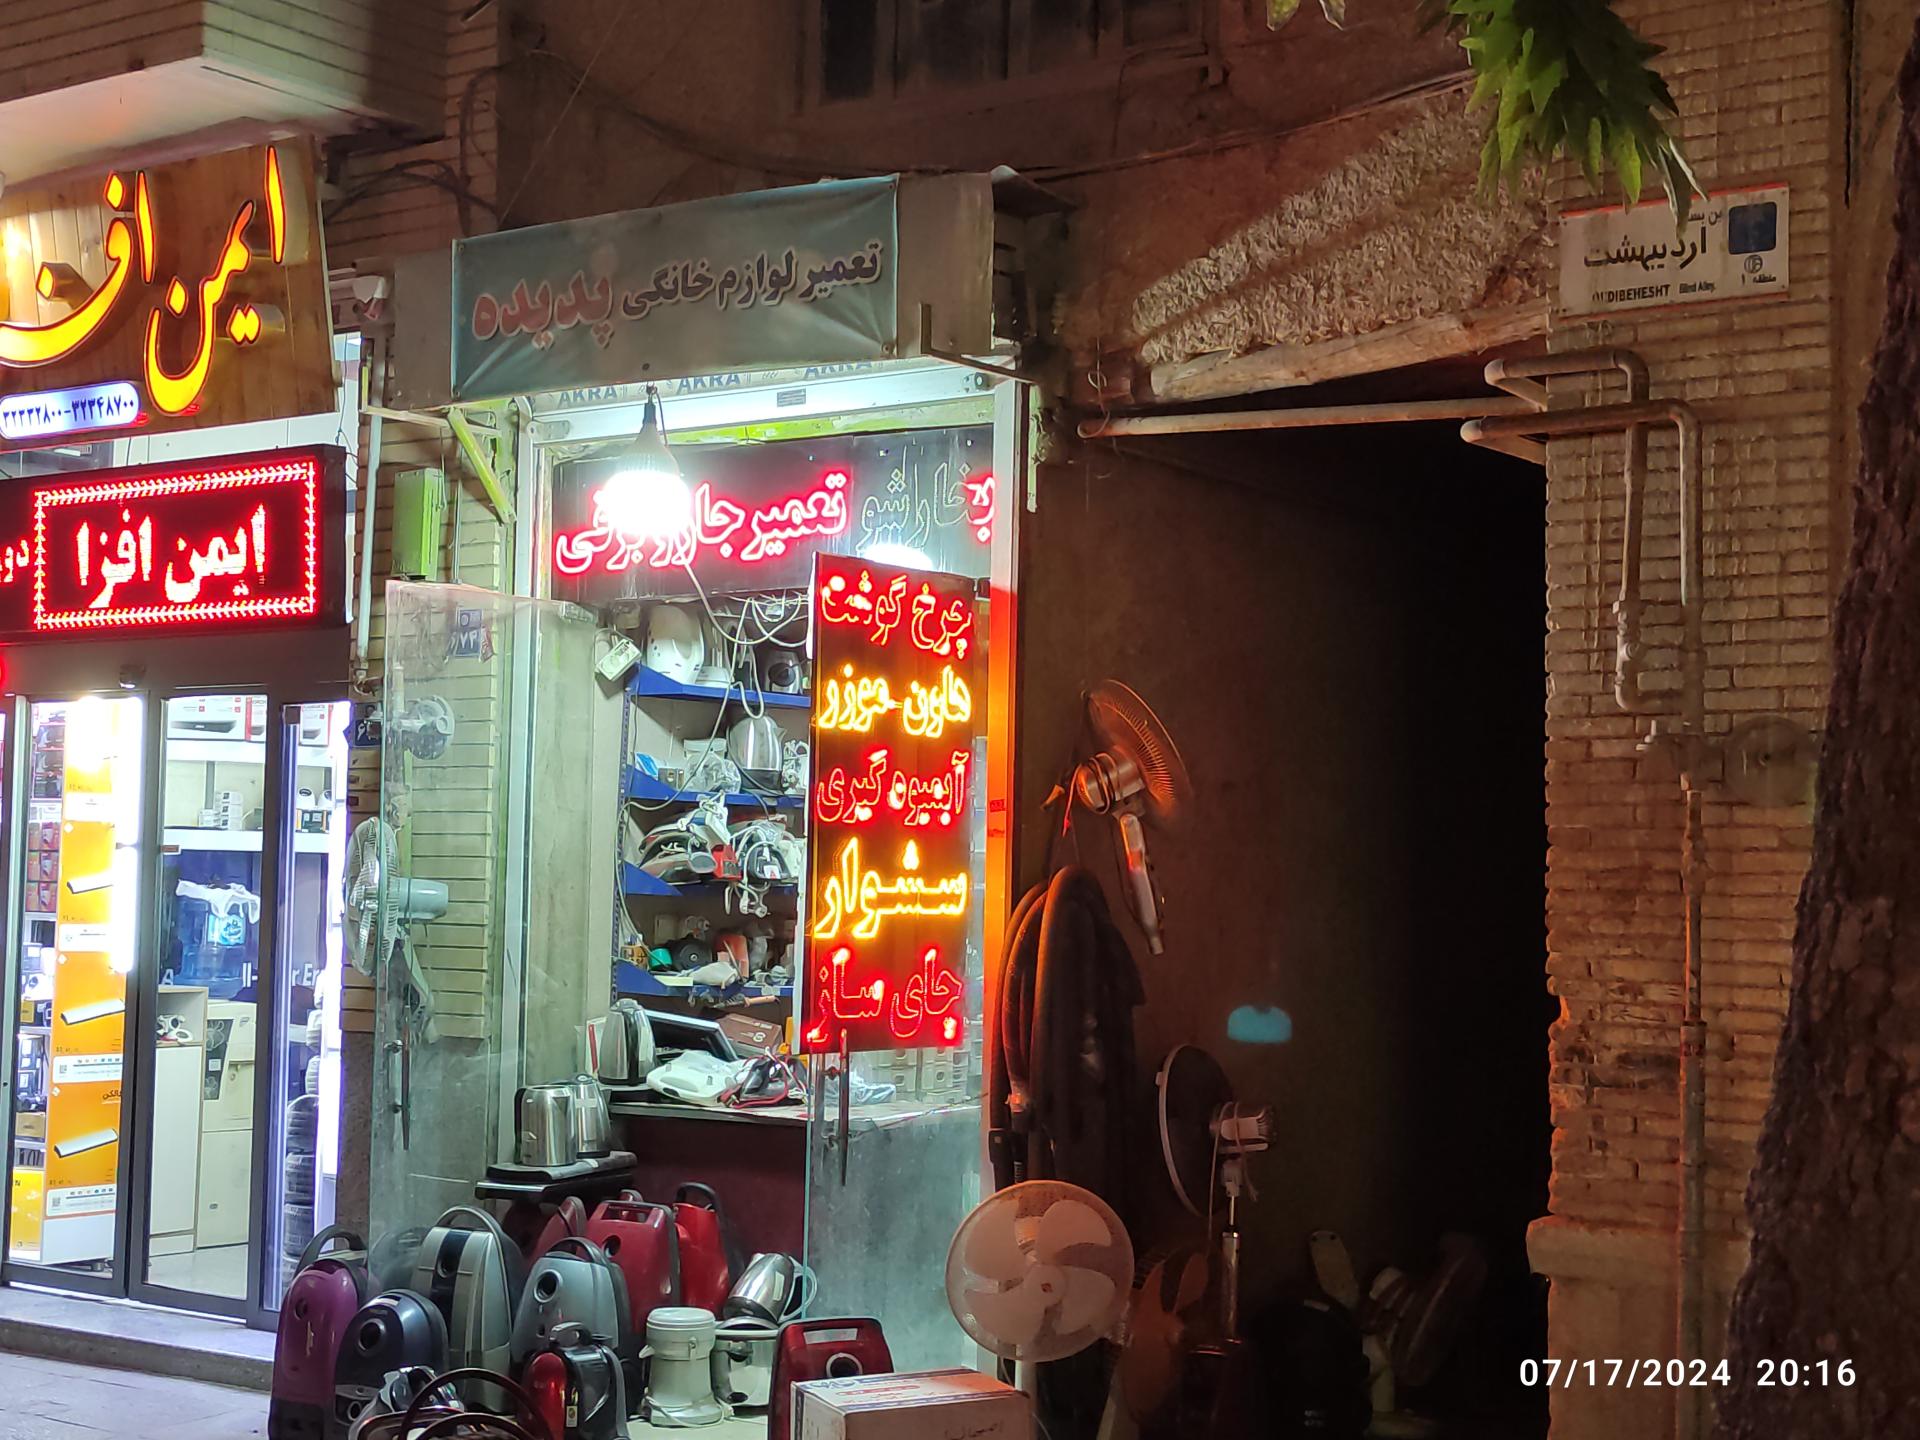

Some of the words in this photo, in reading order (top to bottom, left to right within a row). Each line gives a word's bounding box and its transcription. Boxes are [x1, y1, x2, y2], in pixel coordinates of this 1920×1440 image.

[144, 145, 287, 417] ایمن
[716, 247, 797, 312] لوازم
[798, 240, 882, 304] تعمیر
[1584, 225, 1707, 272] اردیبهشت
[472, 270, 614, 350] پدیده
[622, 260, 715, 320] خانگی
[559, 386, 617, 408] AKRA
[677, 373, 741, 396] AKRA
[164, 502, 267, 604] ایمن
[740, 471, 847, 561] تعمیر
[76, 507, 154, 609] افزا
[820, 569, 908, 646] گوشت
[911, 582, 973, 660] چرخ
[812, 835, 969, 940] سشوار
[805, 947, 886, 1043] ساز
[889, 948, 964, 1040] چای
